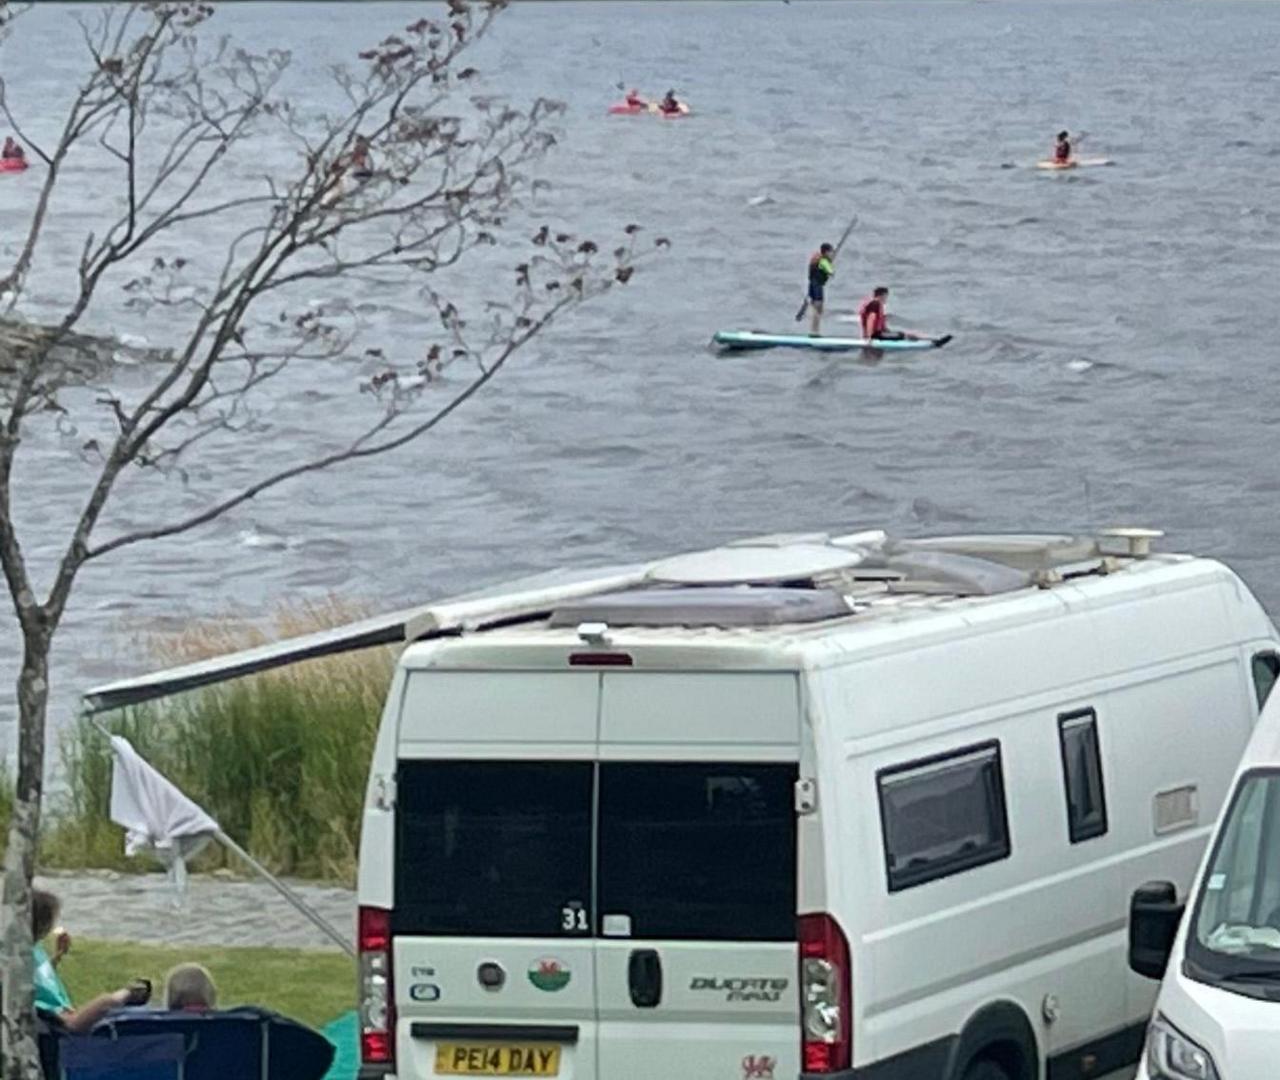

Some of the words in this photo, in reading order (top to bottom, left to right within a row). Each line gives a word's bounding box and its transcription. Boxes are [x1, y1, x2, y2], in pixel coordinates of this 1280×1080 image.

[562, 908, 588, 930] 31
[453, 1047, 501, 1070] PE14
[508, 1047, 554, 1072] DAY
